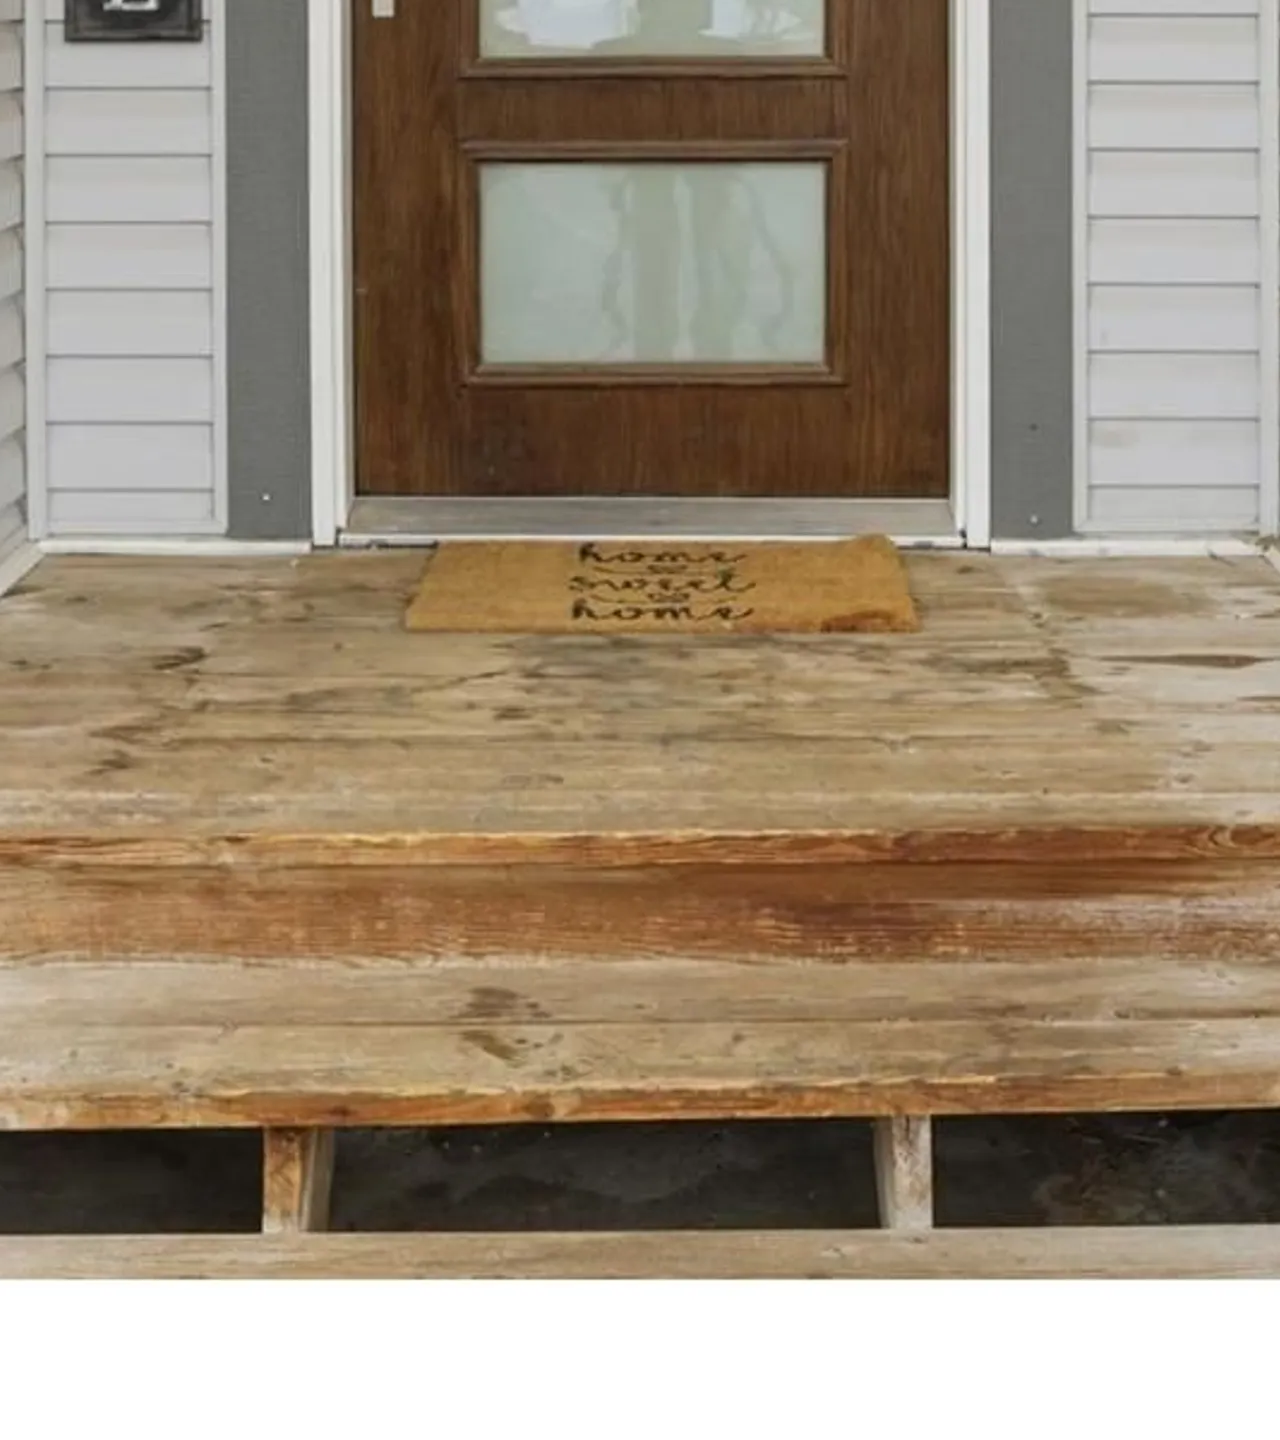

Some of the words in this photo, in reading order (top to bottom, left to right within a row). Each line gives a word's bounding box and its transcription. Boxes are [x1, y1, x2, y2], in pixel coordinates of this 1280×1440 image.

[579, 542, 748, 563] home
[569, 568, 756, 592] sweet
[572, 598, 755, 620] home
